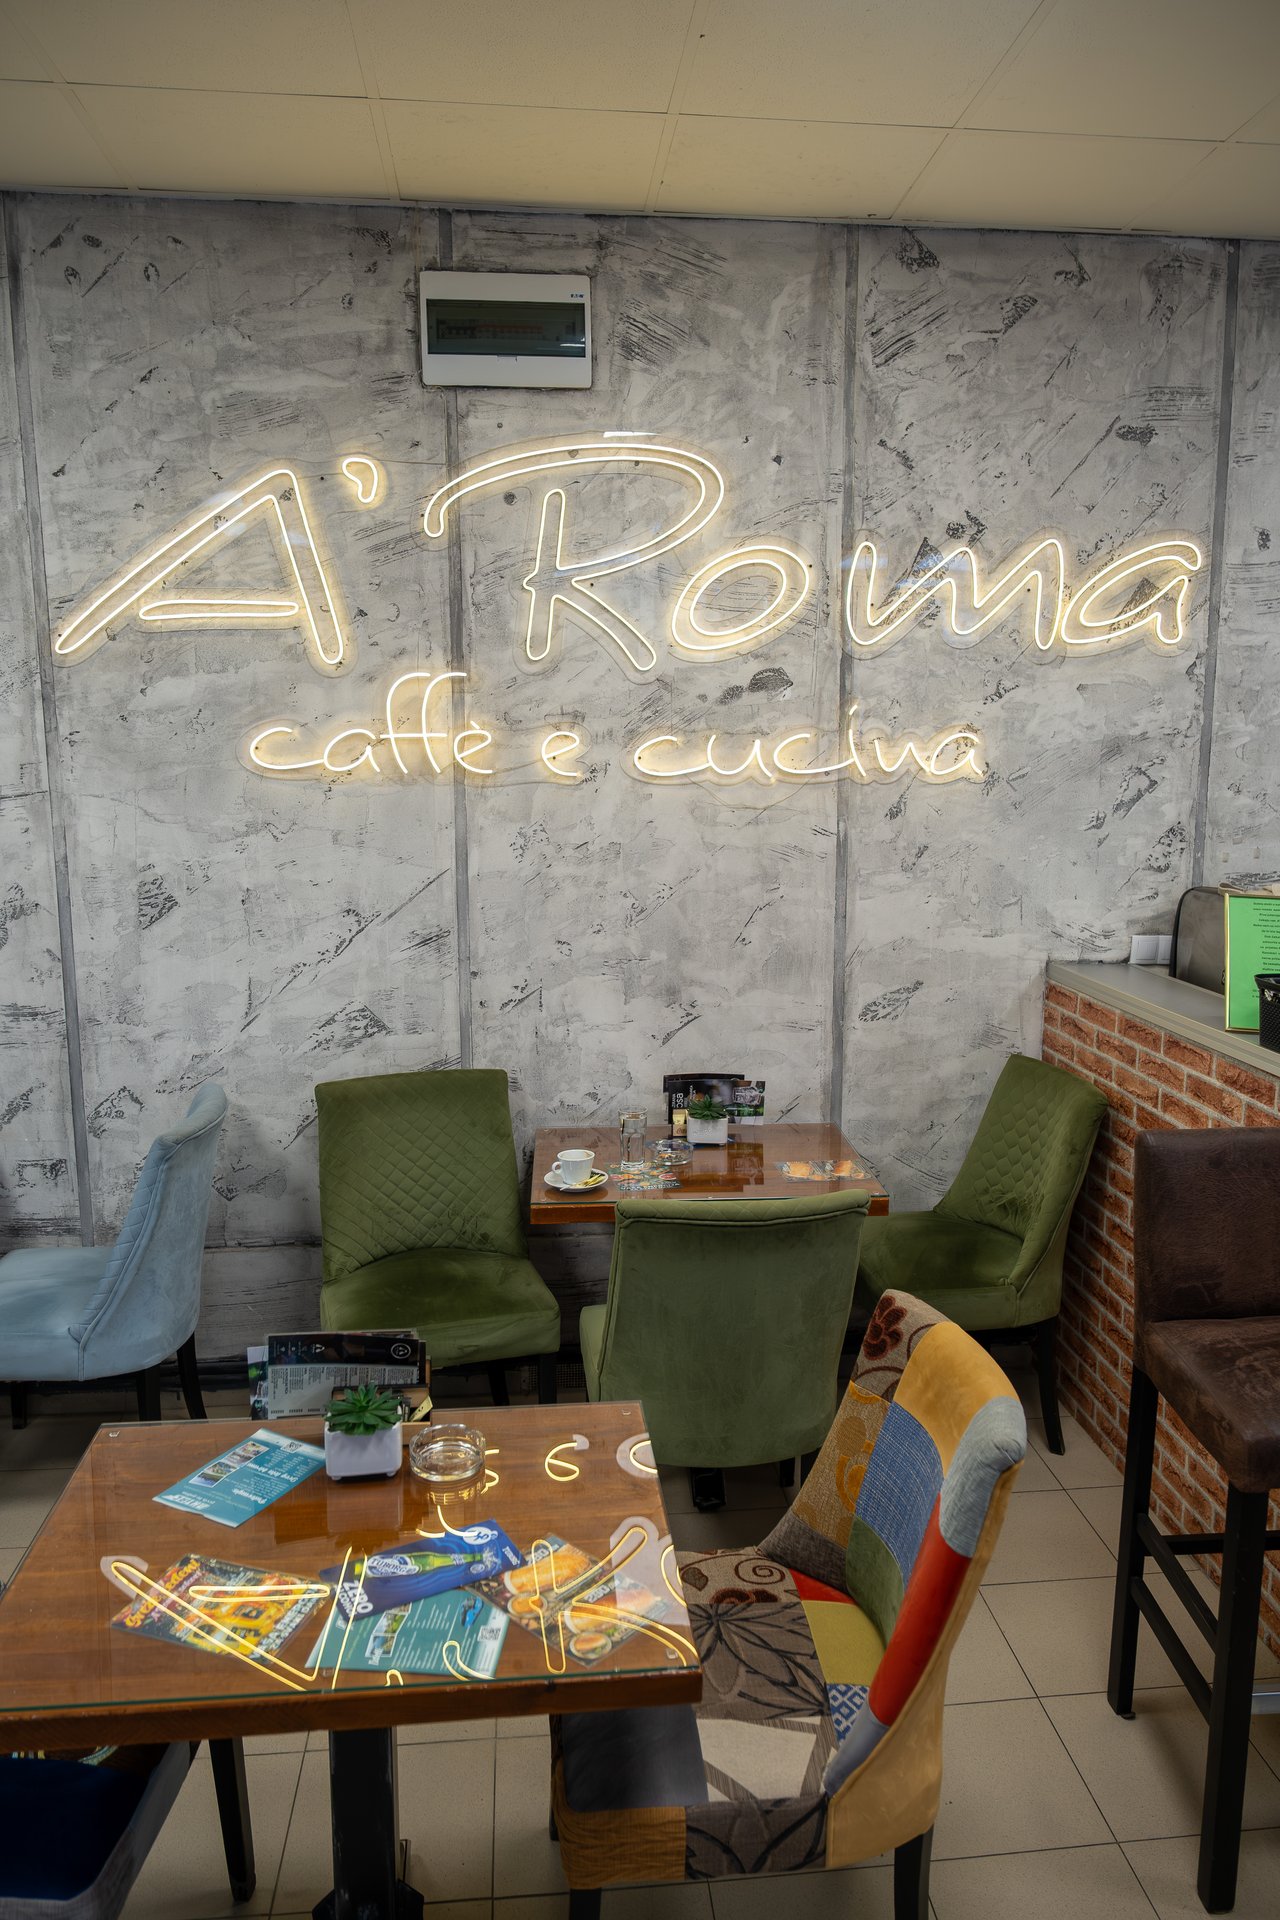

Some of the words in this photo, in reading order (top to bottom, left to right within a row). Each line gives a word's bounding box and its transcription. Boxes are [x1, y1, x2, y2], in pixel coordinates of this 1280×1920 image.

[249, 671, 495, 776] caffè
[541, 731, 583, 777] e
[633, 704, 985, 778] cucina
[343, 1580, 373, 1614] ZERO
